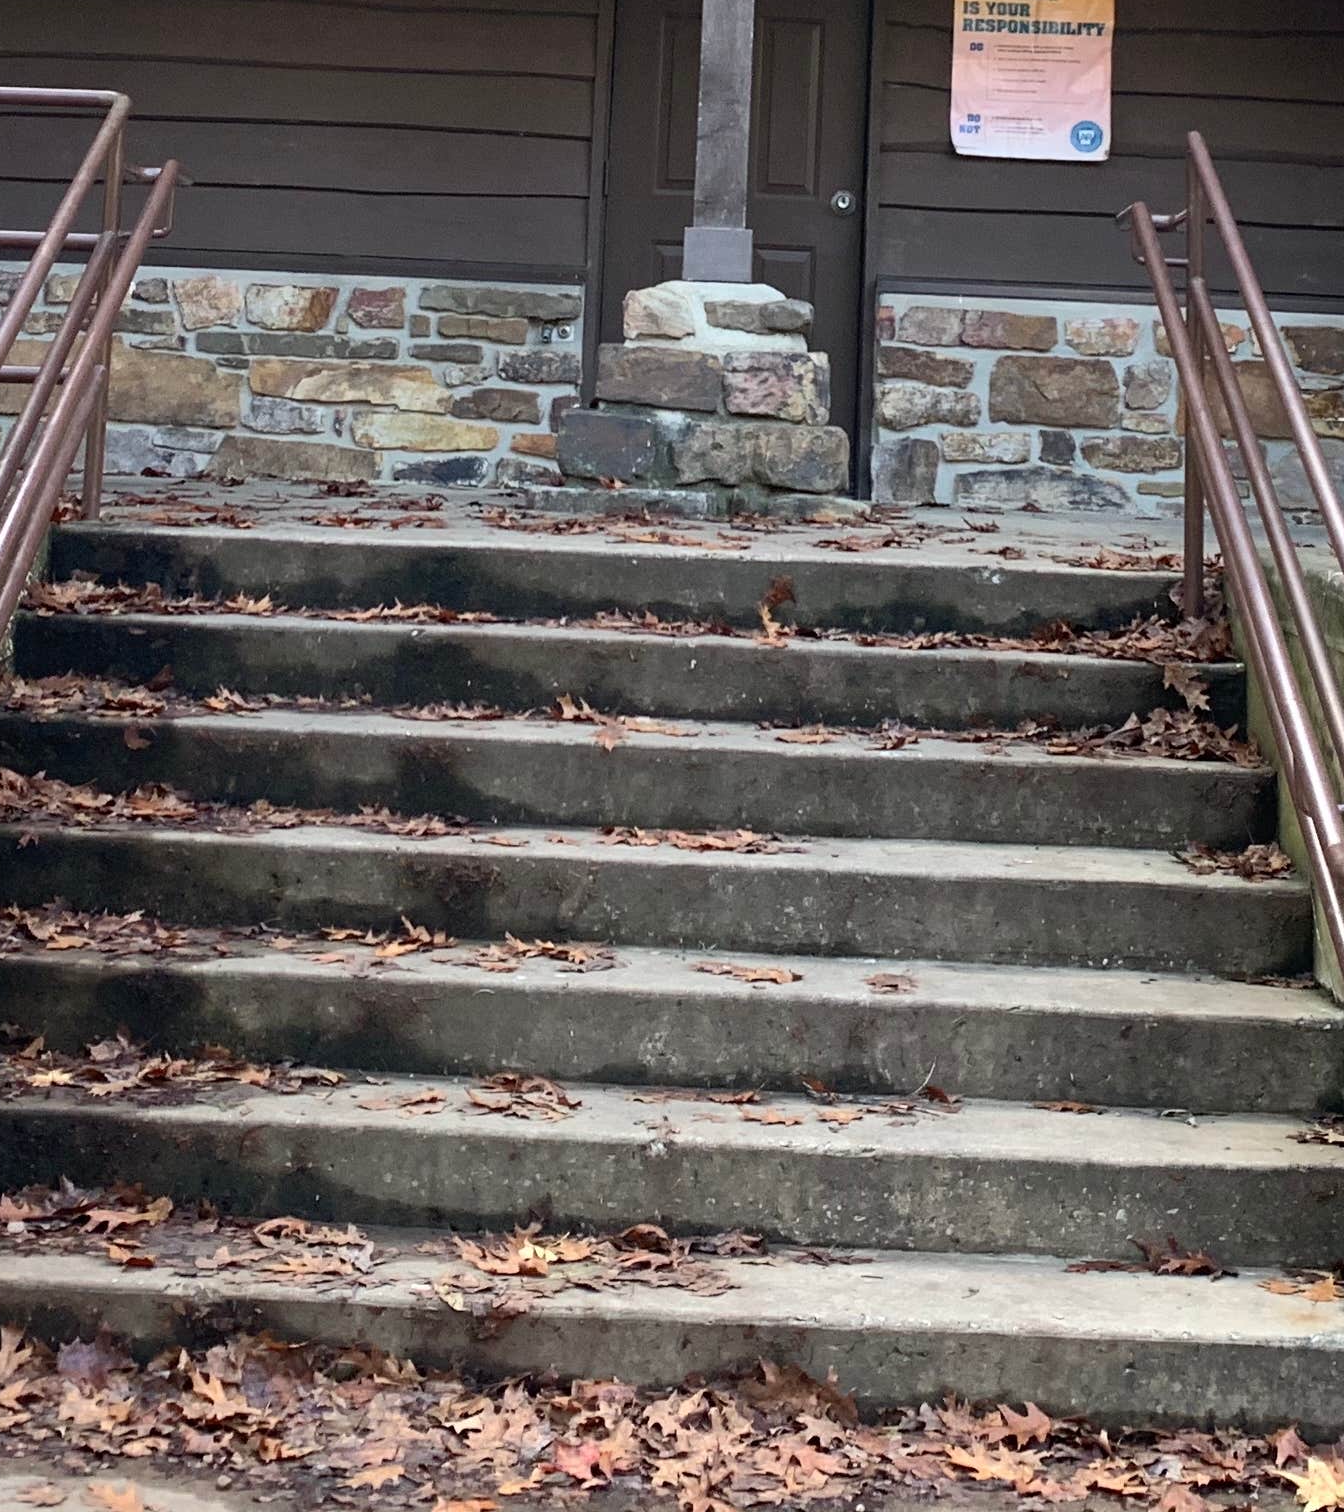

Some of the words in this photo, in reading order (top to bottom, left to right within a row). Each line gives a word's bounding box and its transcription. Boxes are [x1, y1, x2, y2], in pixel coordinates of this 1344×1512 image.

[963, 1, 979, 14] IS
[986, 2, 1030, 16] YOUR
[962, 18, 1105, 36] RESPONSIBILITY
[959, 125, 981, 134] NOT
